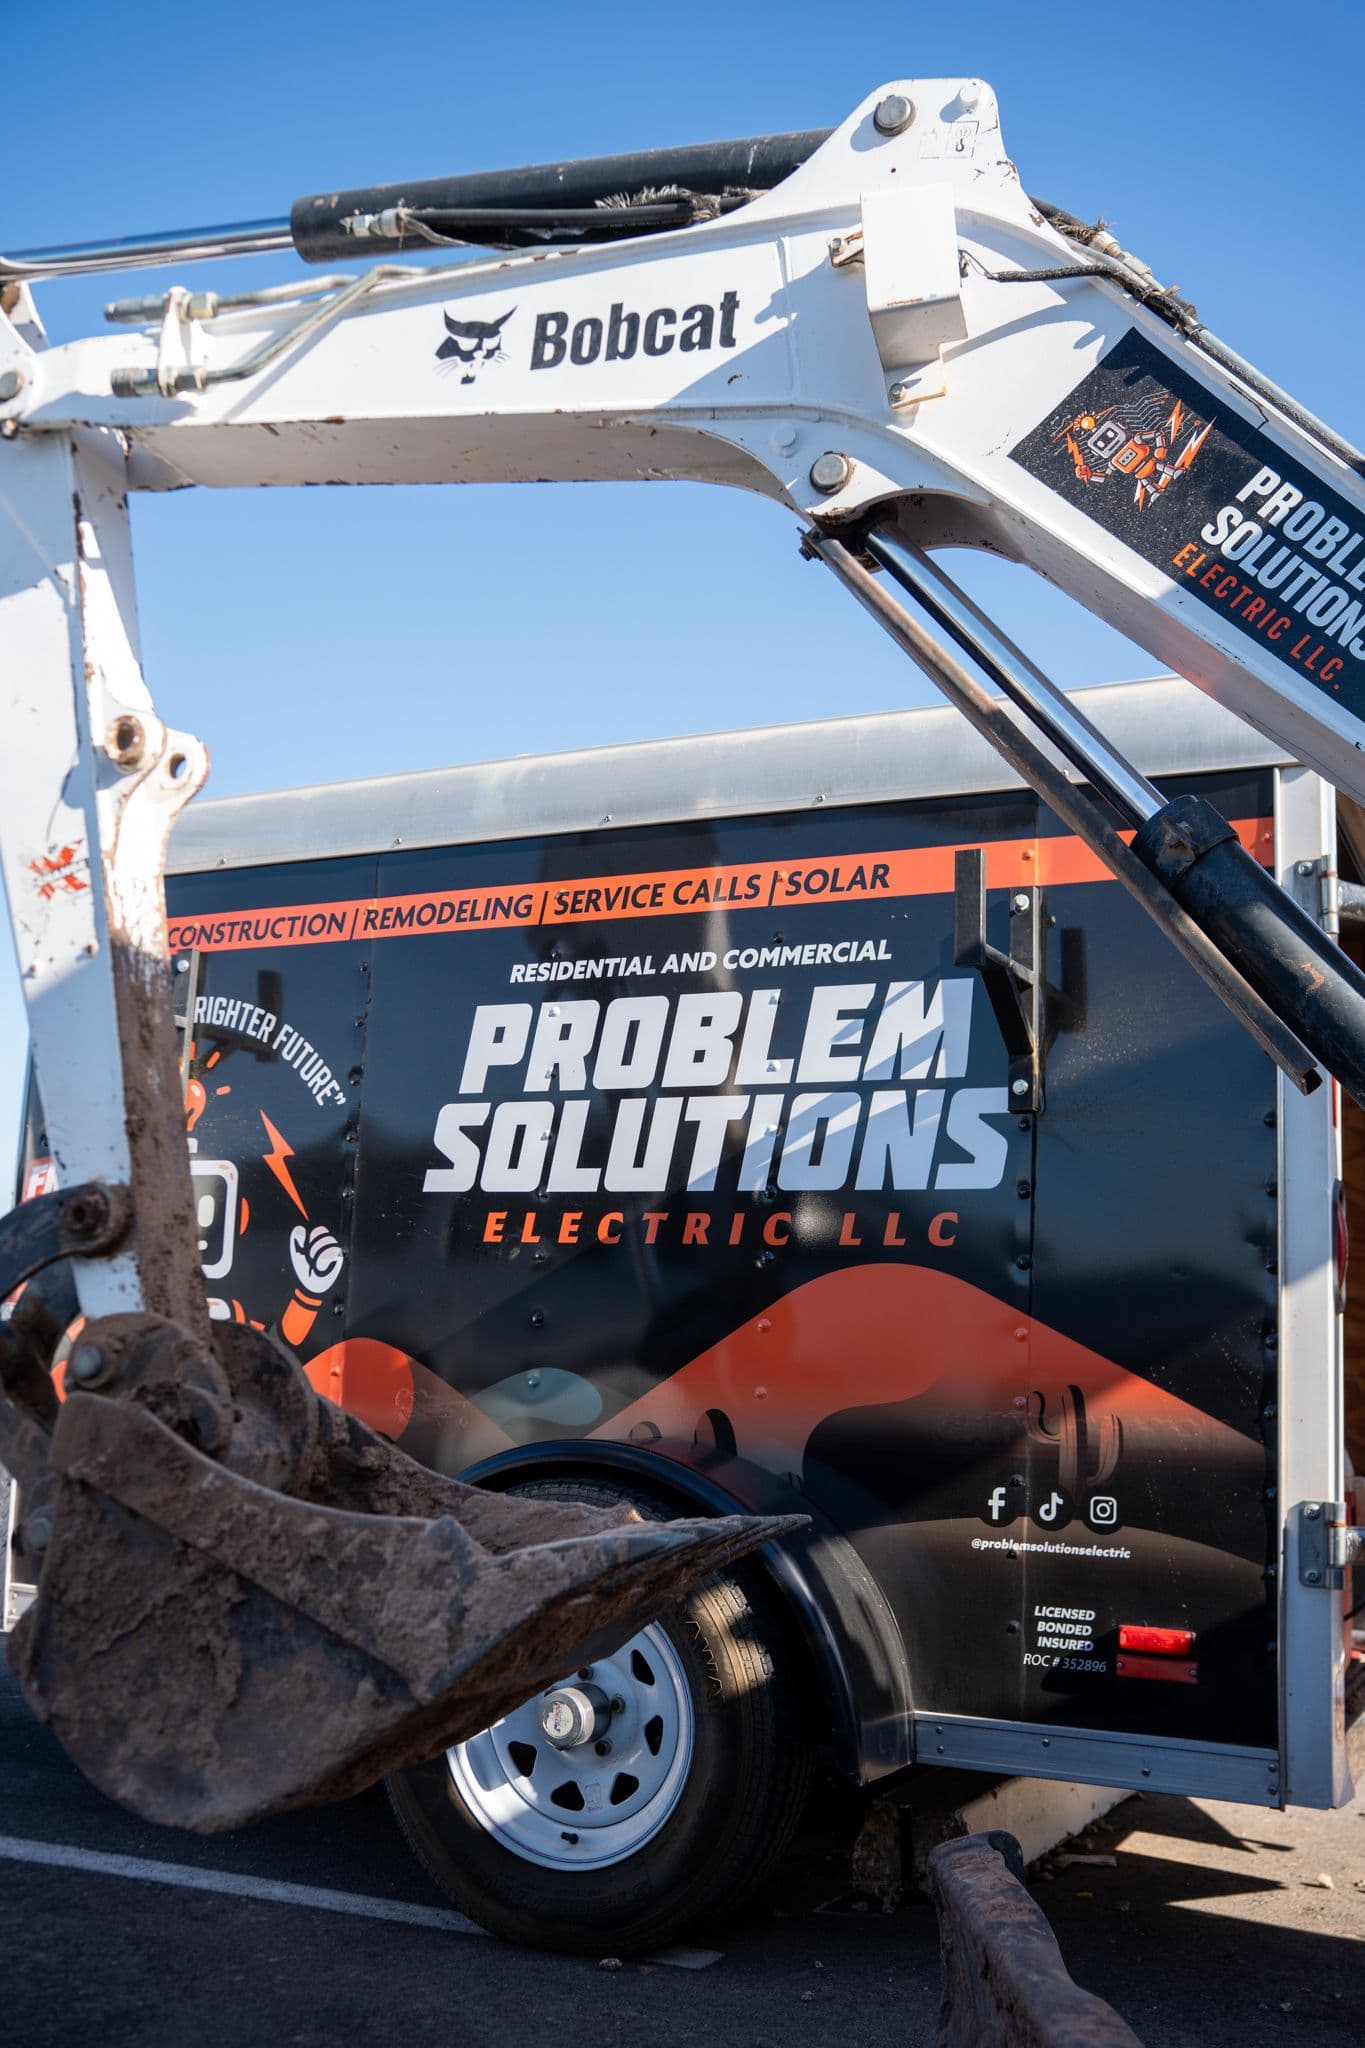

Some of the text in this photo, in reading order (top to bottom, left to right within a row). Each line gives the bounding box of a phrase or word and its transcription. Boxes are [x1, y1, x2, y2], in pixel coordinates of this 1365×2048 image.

[530, 290, 739, 370] Bobcat
[1173, 542, 1344, 690] ELECTRIC LLC.
[168, 863, 889, 948] CONSTRUCTION REMODELING SERVICE CALLS SOLAR
[510, 939, 892, 983] RESIDENTIAL AND COMMERCIAL
[194, 996, 276, 1043] RIGHTER
[458, 978, 974, 1094] PROBLEM
[422, 1087, 1010, 1192] SOLUTIONS
[483, 1211, 959, 1246] ELECTRIC LLC
[971, 1538, 1131, 1559] @problemsolutionselectric
[1034, 1605, 1096, 1621] LICENSED
[1036, 1621, 1092, 1636] BONDED
[1023, 1653, 1107, 1673] ROC # 352896
[1037, 1636, 1094, 1651] INSURED
